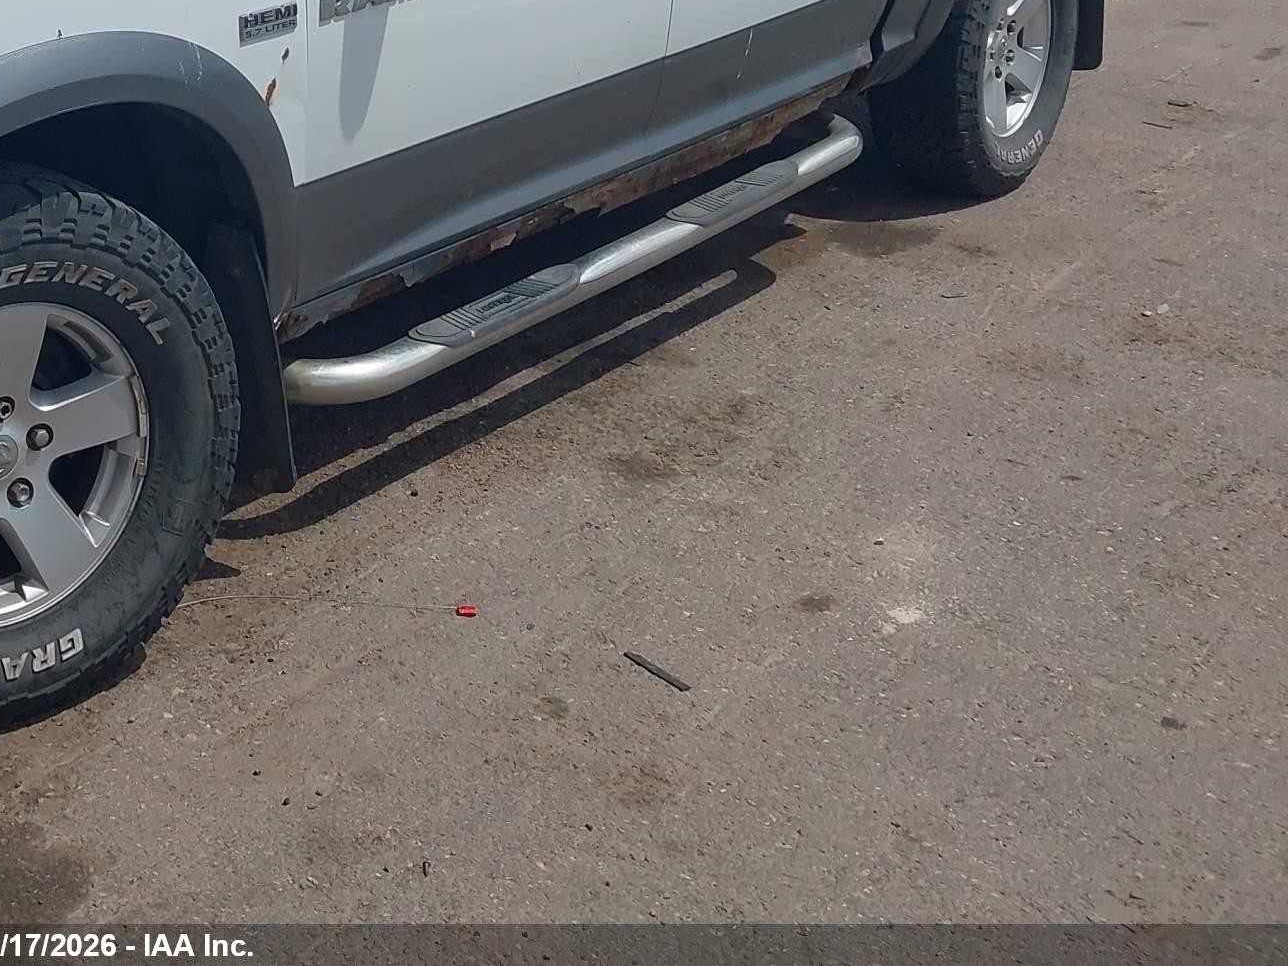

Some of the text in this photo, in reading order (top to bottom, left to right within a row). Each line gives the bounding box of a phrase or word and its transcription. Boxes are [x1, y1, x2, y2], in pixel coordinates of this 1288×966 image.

[239, 3, 298, 30] HEMI
[244, 19, 297, 41] 5.7 LITER
